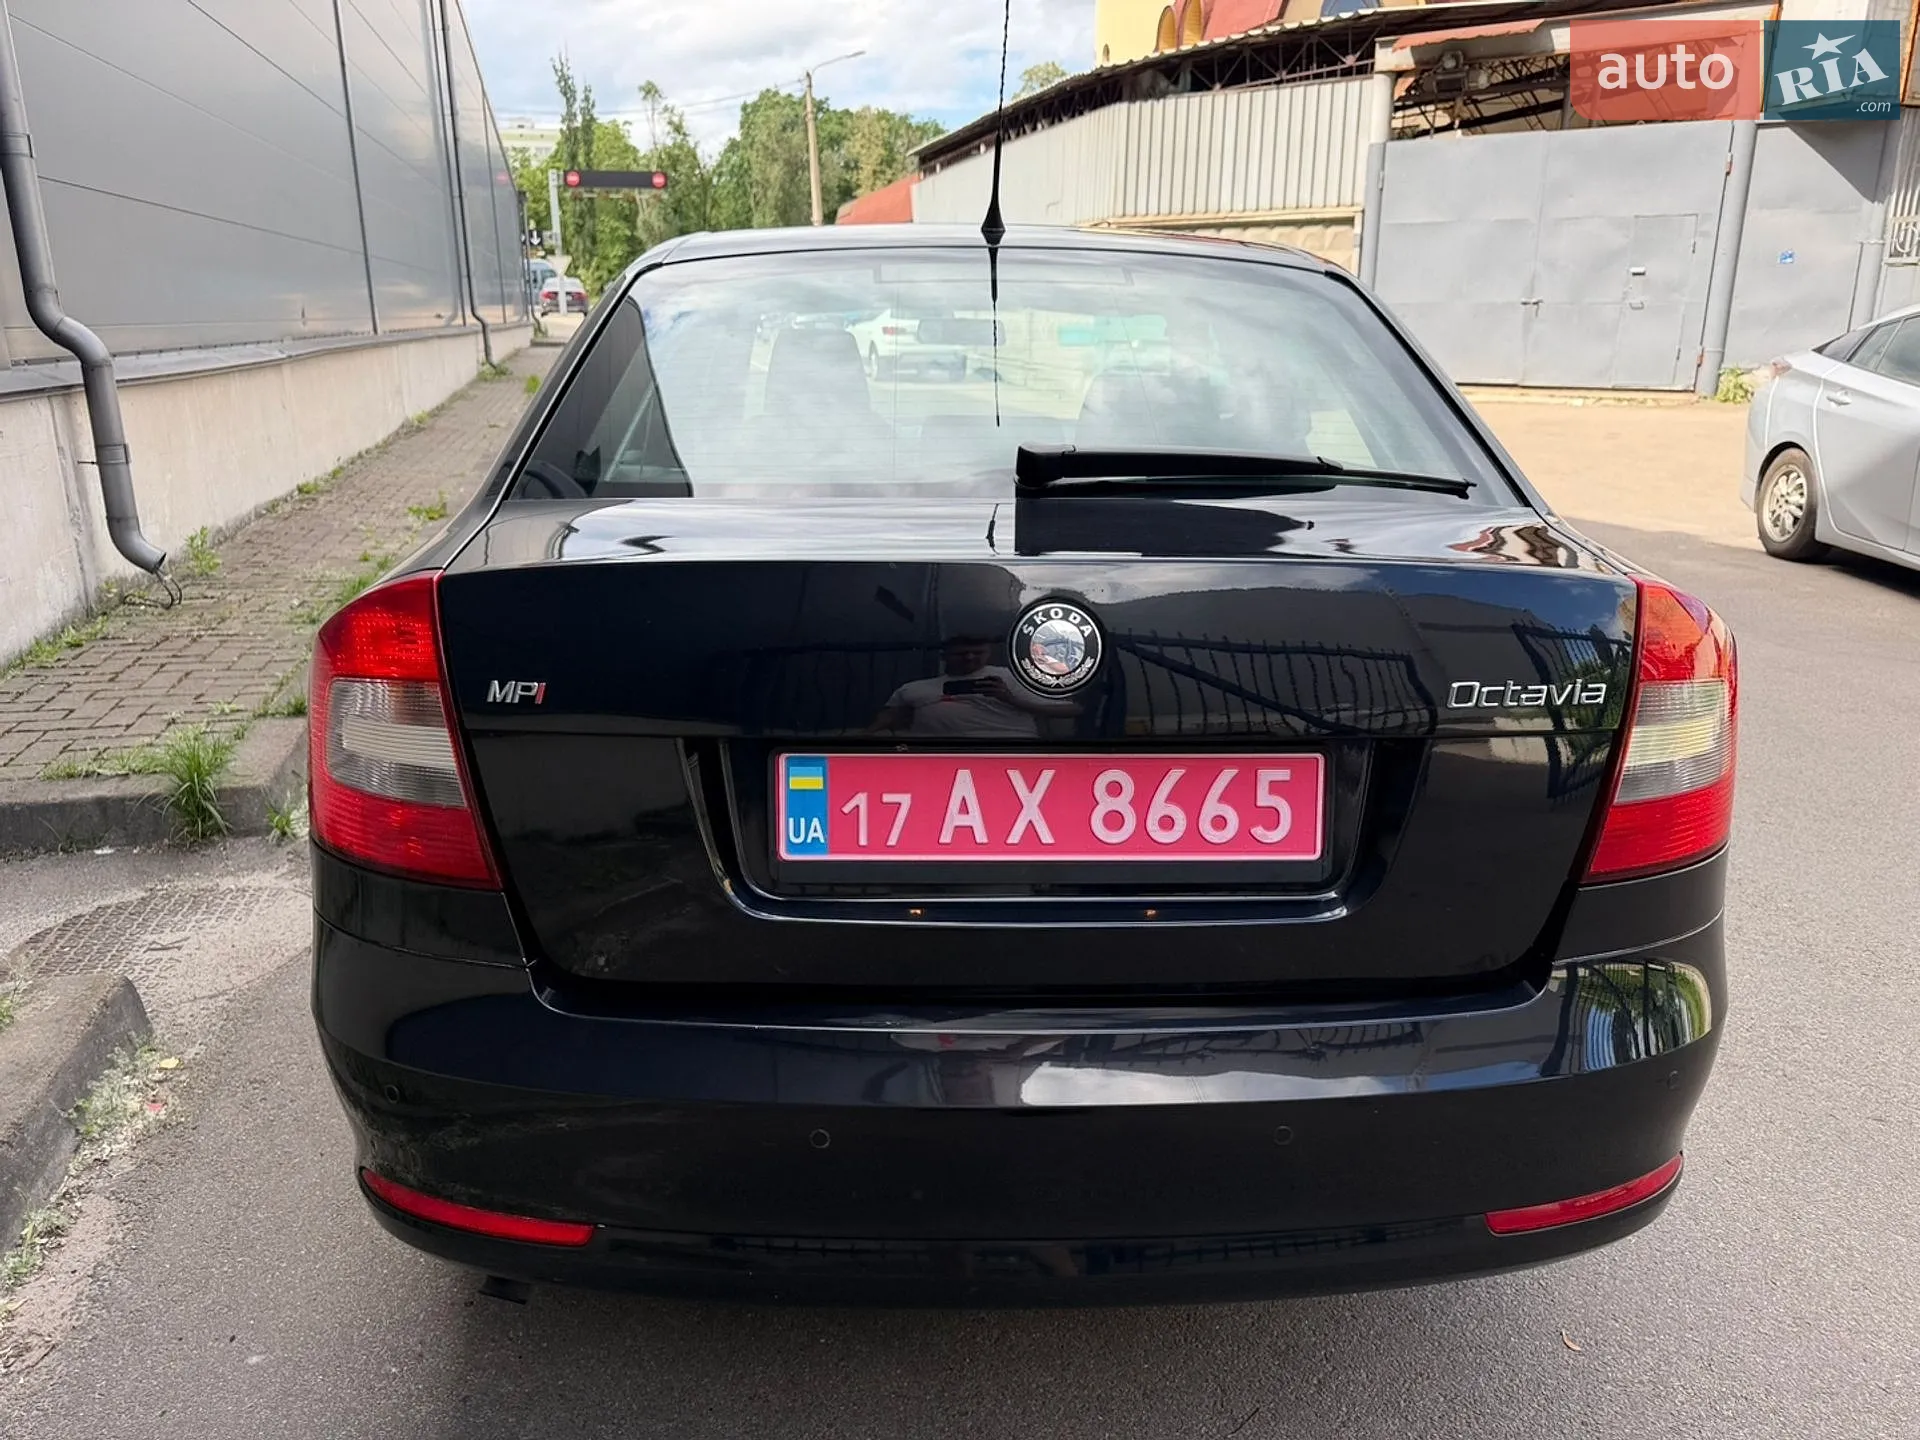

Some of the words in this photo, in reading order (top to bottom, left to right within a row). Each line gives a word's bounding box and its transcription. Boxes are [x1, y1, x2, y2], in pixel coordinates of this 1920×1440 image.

[1447, 678, 1607, 708] Octavia
[841, 791, 912, 847] 17
[938, 768, 1056, 845] AX
[1089, 768, 1293, 845] 8665
[788, 816, 826, 844] UA
